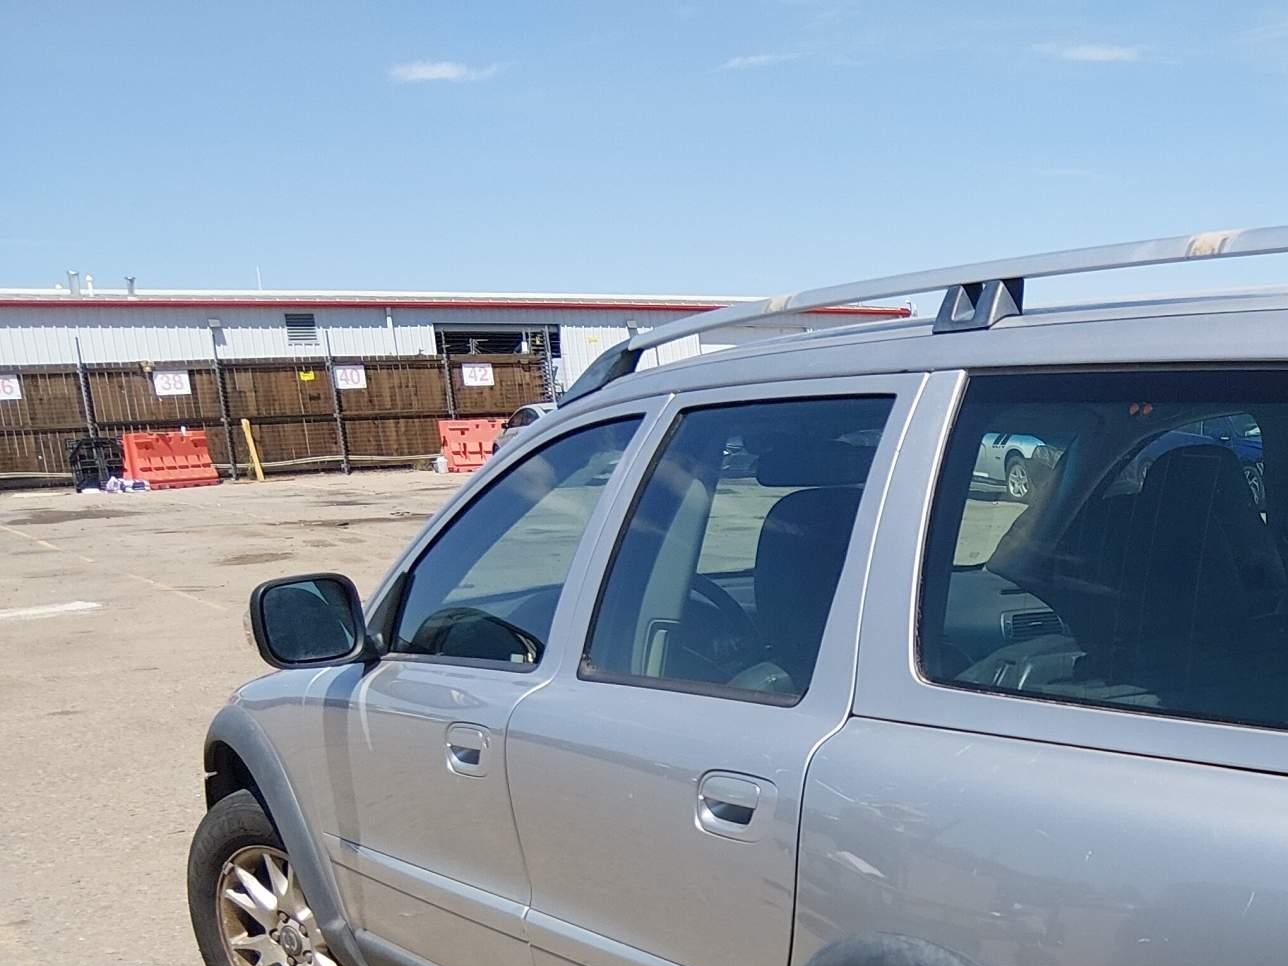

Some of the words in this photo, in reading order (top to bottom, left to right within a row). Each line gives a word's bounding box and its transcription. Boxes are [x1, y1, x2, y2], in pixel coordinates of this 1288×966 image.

[340, 368, 361, 385] 40
[468, 367, 489, 382] 42
[160, 375, 184, 391] 38
